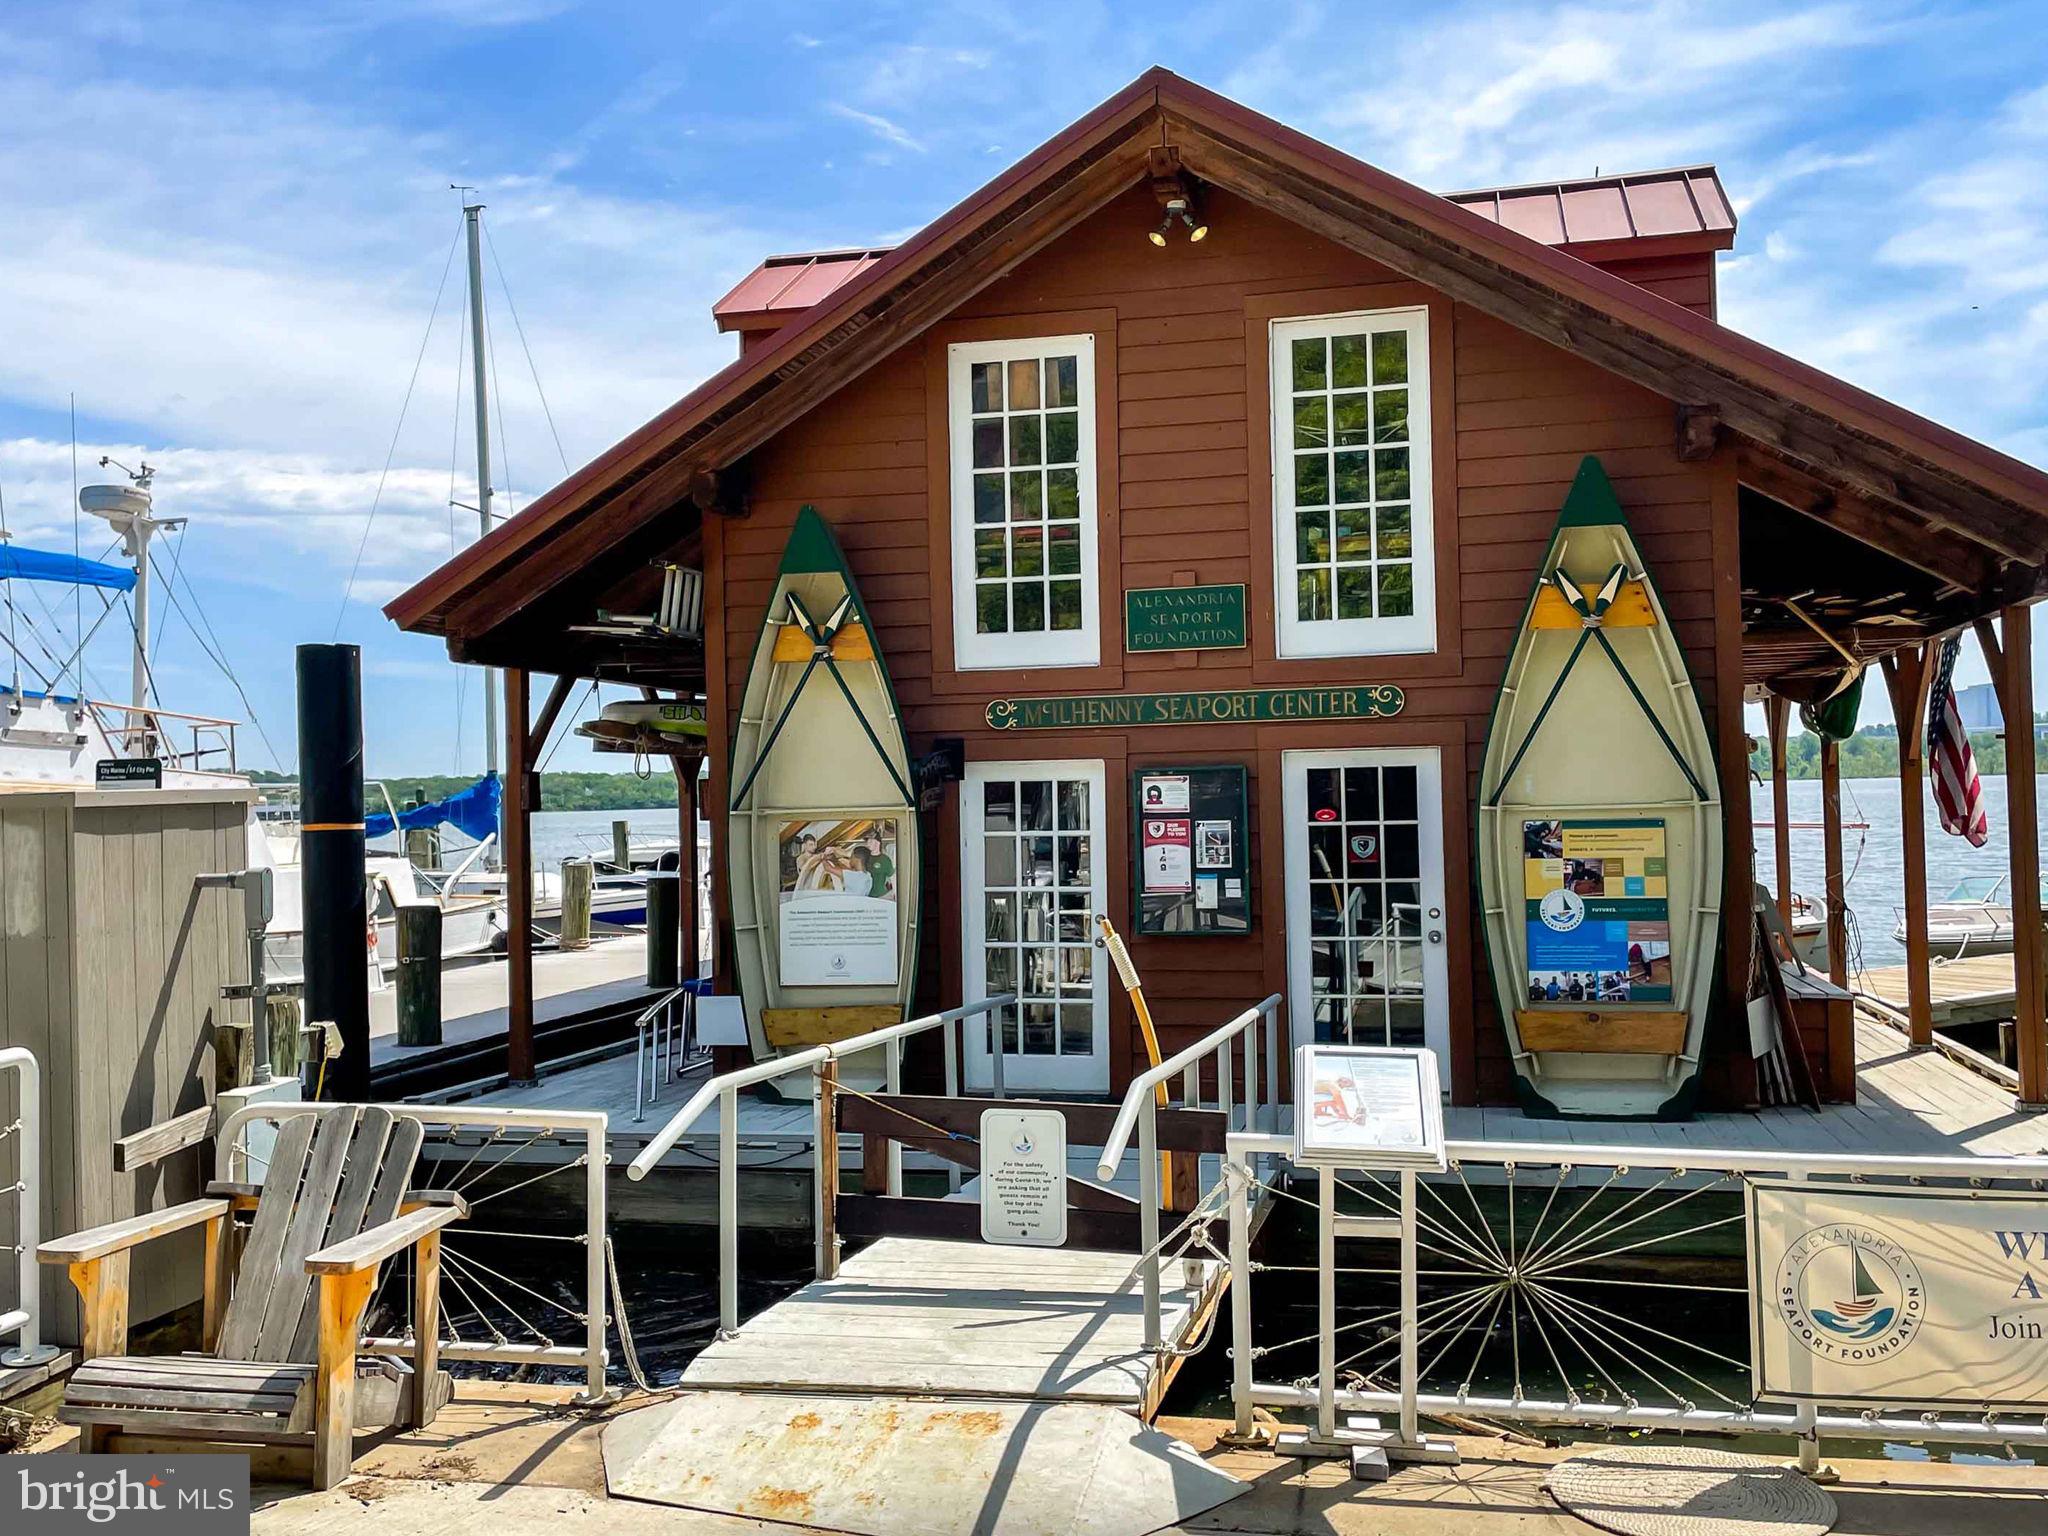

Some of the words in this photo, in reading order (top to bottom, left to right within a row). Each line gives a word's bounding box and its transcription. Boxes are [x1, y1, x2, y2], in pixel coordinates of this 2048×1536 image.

[1136, 593, 1236, 608] ALEXANDRIA
[1150, 611, 1223, 625] SEAPORT
[1134, 629, 1238, 645] FOUNDATION
[1153, 694, 1258, 722] SEAPORT
[1269, 690, 1359, 716] CENTER
[1791, 1228, 1903, 1267] ALEXANDRIA
[1782, 1286, 1834, 1354] SEAPORT
[1841, 1286, 1920, 1360] FOUNDATION
[1989, 1315, 2042, 1339] Join
